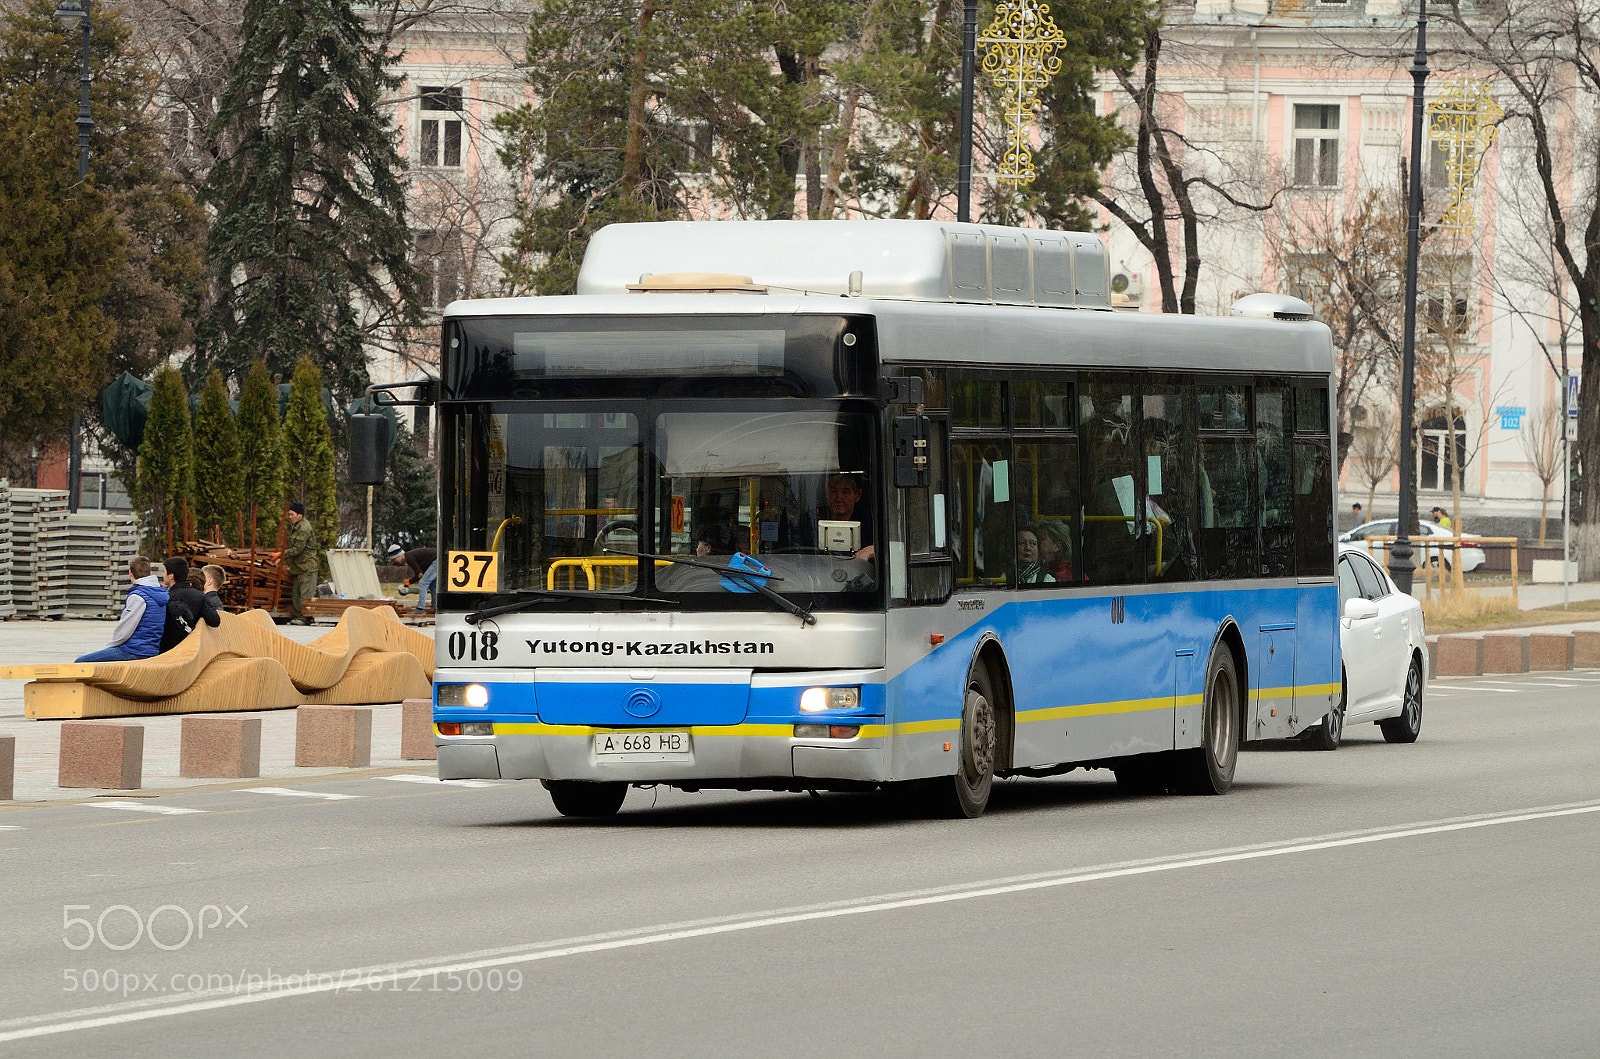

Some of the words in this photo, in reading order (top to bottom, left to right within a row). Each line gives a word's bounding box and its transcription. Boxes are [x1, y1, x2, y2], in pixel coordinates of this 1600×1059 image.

[1503, 417, 1519, 428] 102
[451, 554, 494, 588] 37
[1111, 596, 1125, 624] 018
[448, 630, 499, 661] 018
[525, 639, 775, 656] Yutong-Kazakhstan
[604, 735, 615, 751] A
[623, 734, 652, 751] 668
